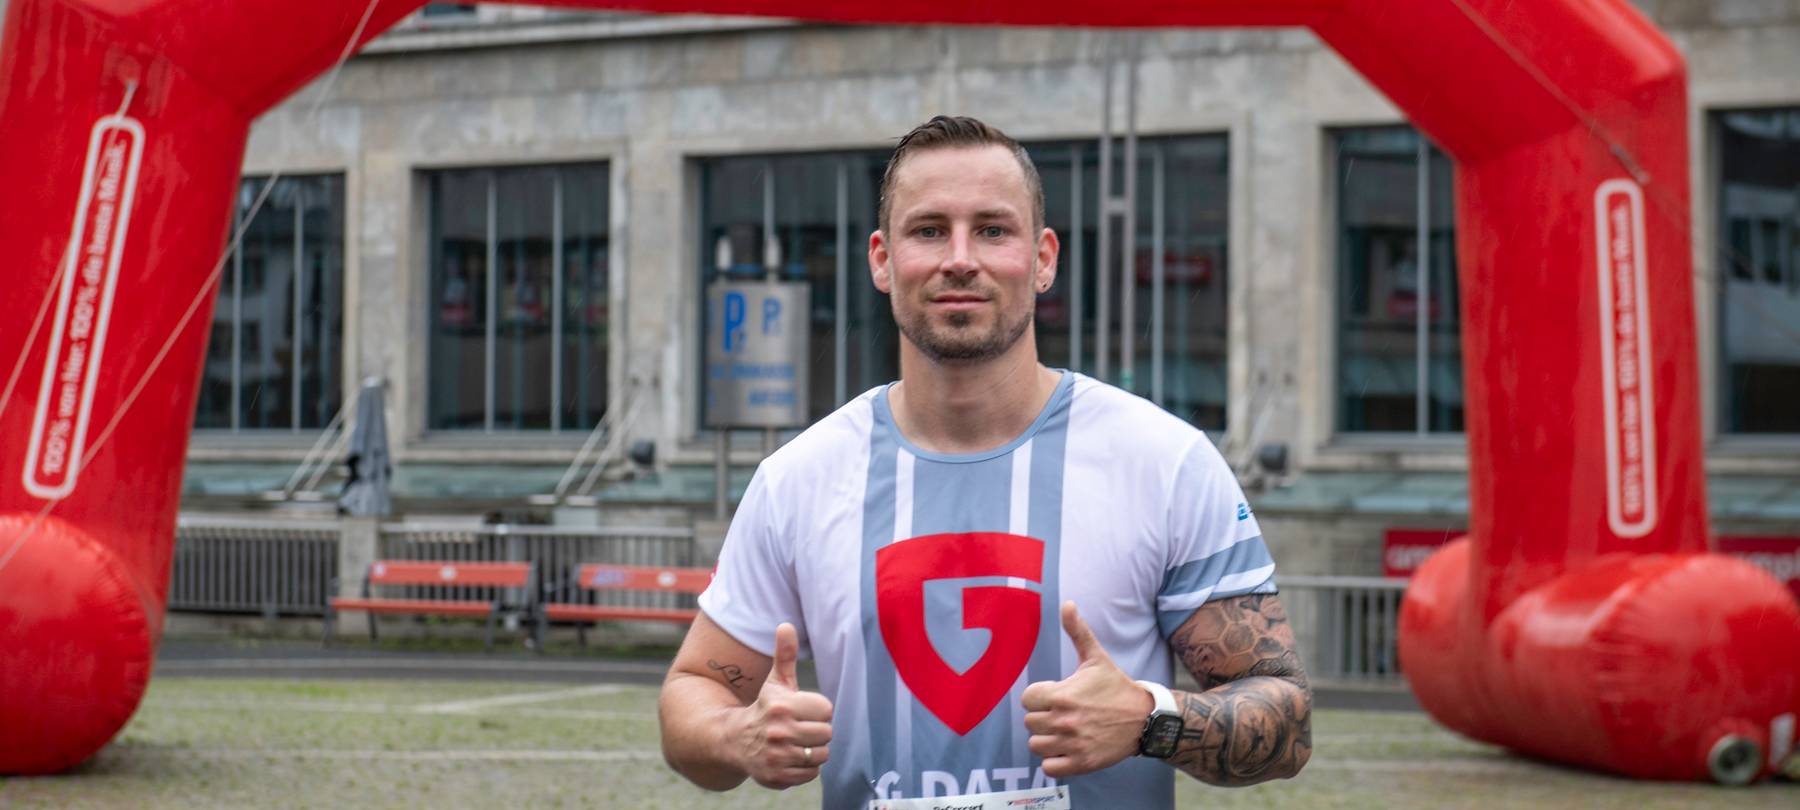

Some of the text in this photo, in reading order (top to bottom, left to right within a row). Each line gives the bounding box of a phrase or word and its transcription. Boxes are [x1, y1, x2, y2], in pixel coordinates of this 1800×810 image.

[43, 419, 71, 476] 100%
[59, 383, 78, 417] von
[70, 285, 97, 341] 100%
[876, 531, 1046, 737] G
